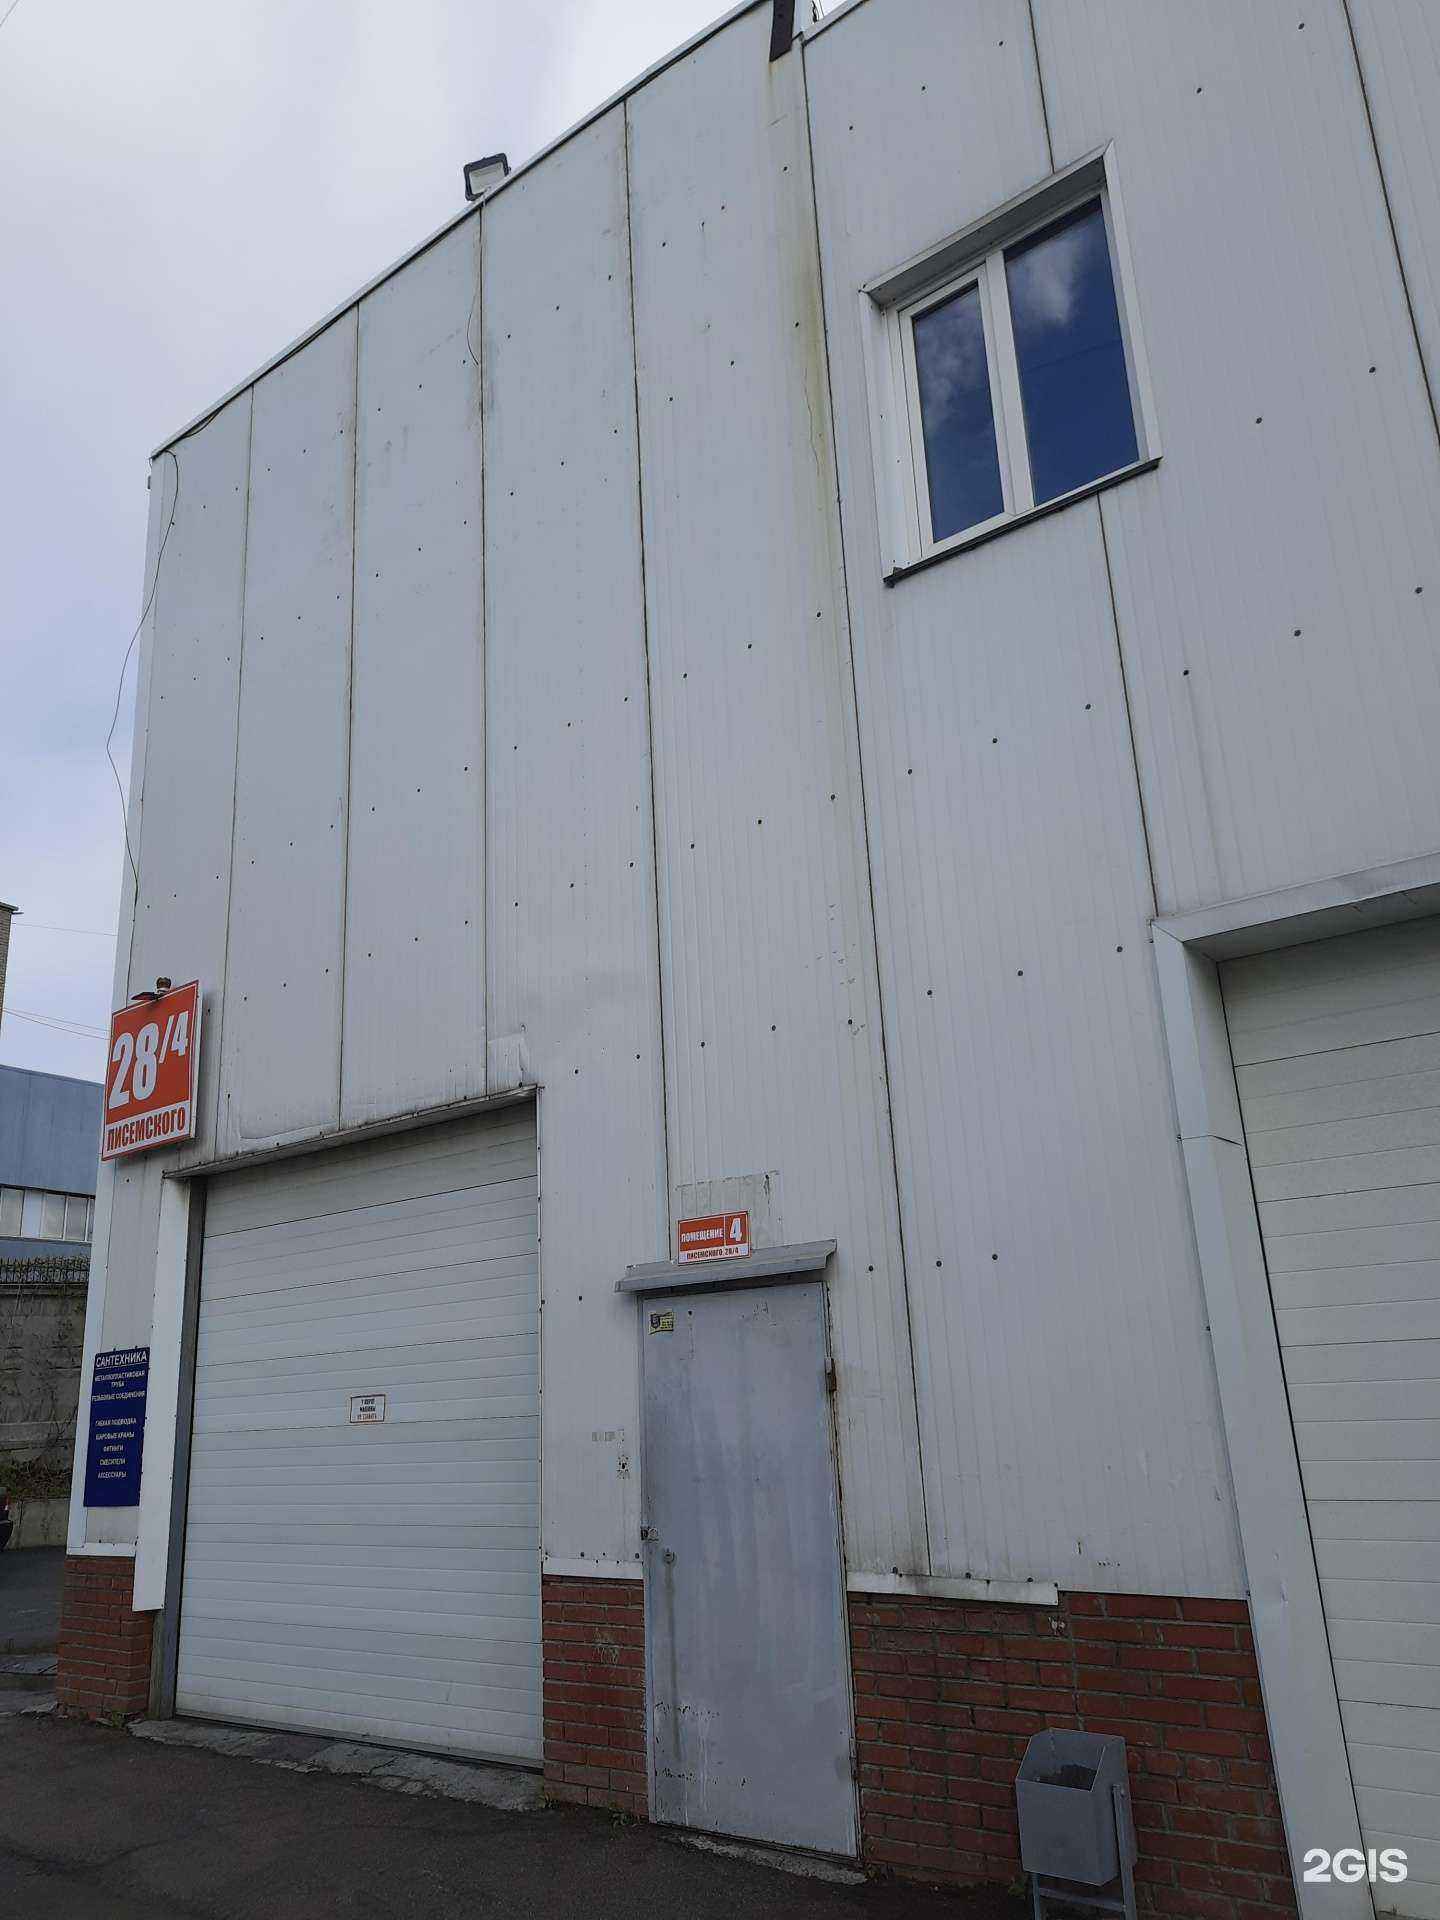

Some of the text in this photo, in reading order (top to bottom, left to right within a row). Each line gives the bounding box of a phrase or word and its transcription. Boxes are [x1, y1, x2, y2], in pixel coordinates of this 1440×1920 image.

[109, 1011, 189, 1109] 28/4
[107, 1107, 186, 1150] ПИСЕМСКОГО
[681, 1217, 742, 1242] ПОМЕЩЕНИЕ 4
[687, 1248, 723, 1259] ПИСЕМСКОГО
[96, 1351, 147, 1367] САНТЕХНИКА
